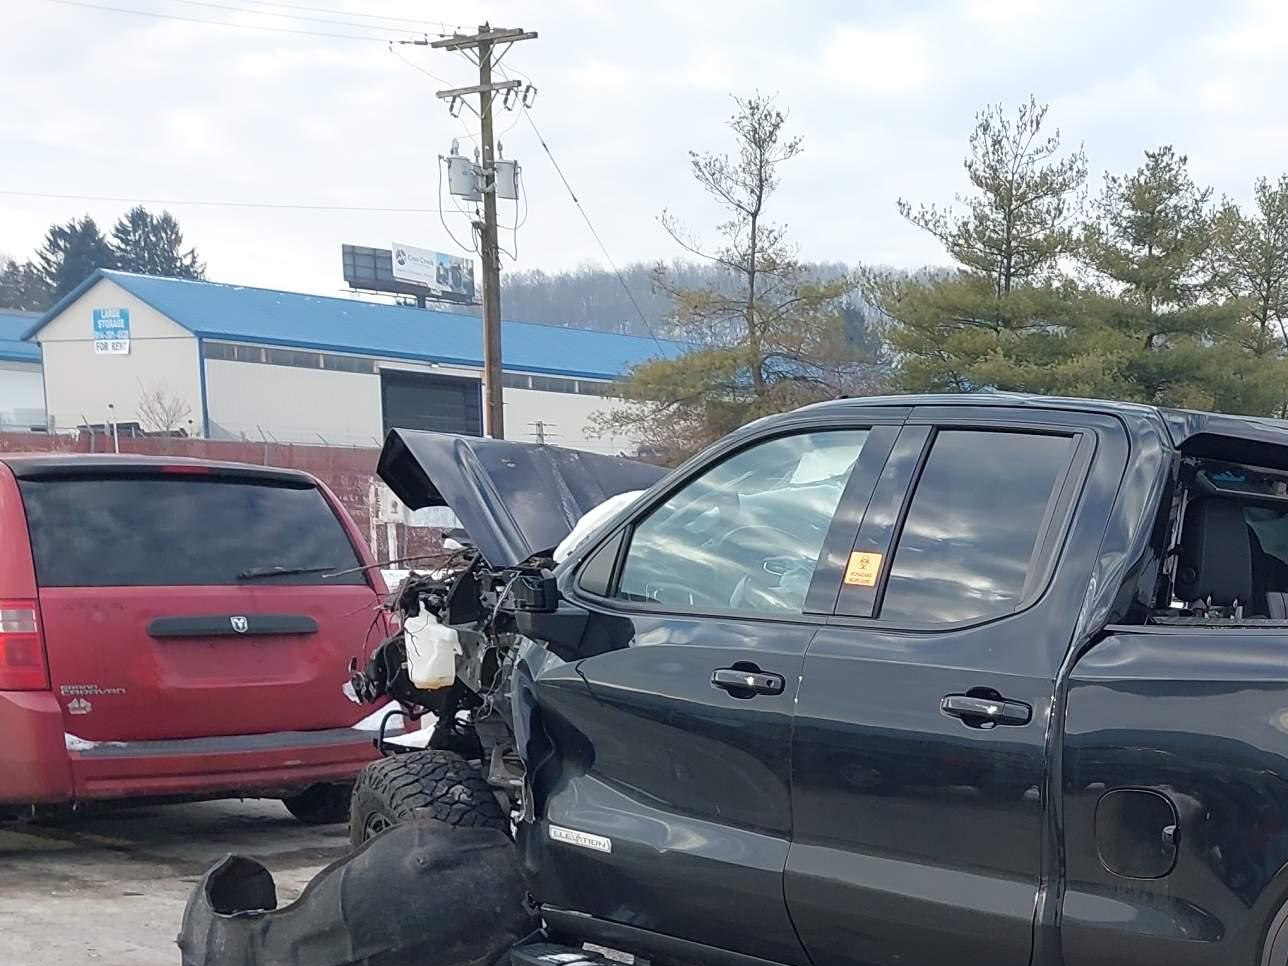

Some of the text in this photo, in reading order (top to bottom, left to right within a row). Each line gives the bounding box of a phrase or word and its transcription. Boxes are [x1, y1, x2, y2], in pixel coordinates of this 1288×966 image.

[96, 341, 128, 351] FOR RENT
[552, 829, 607, 850] ELEVATION
